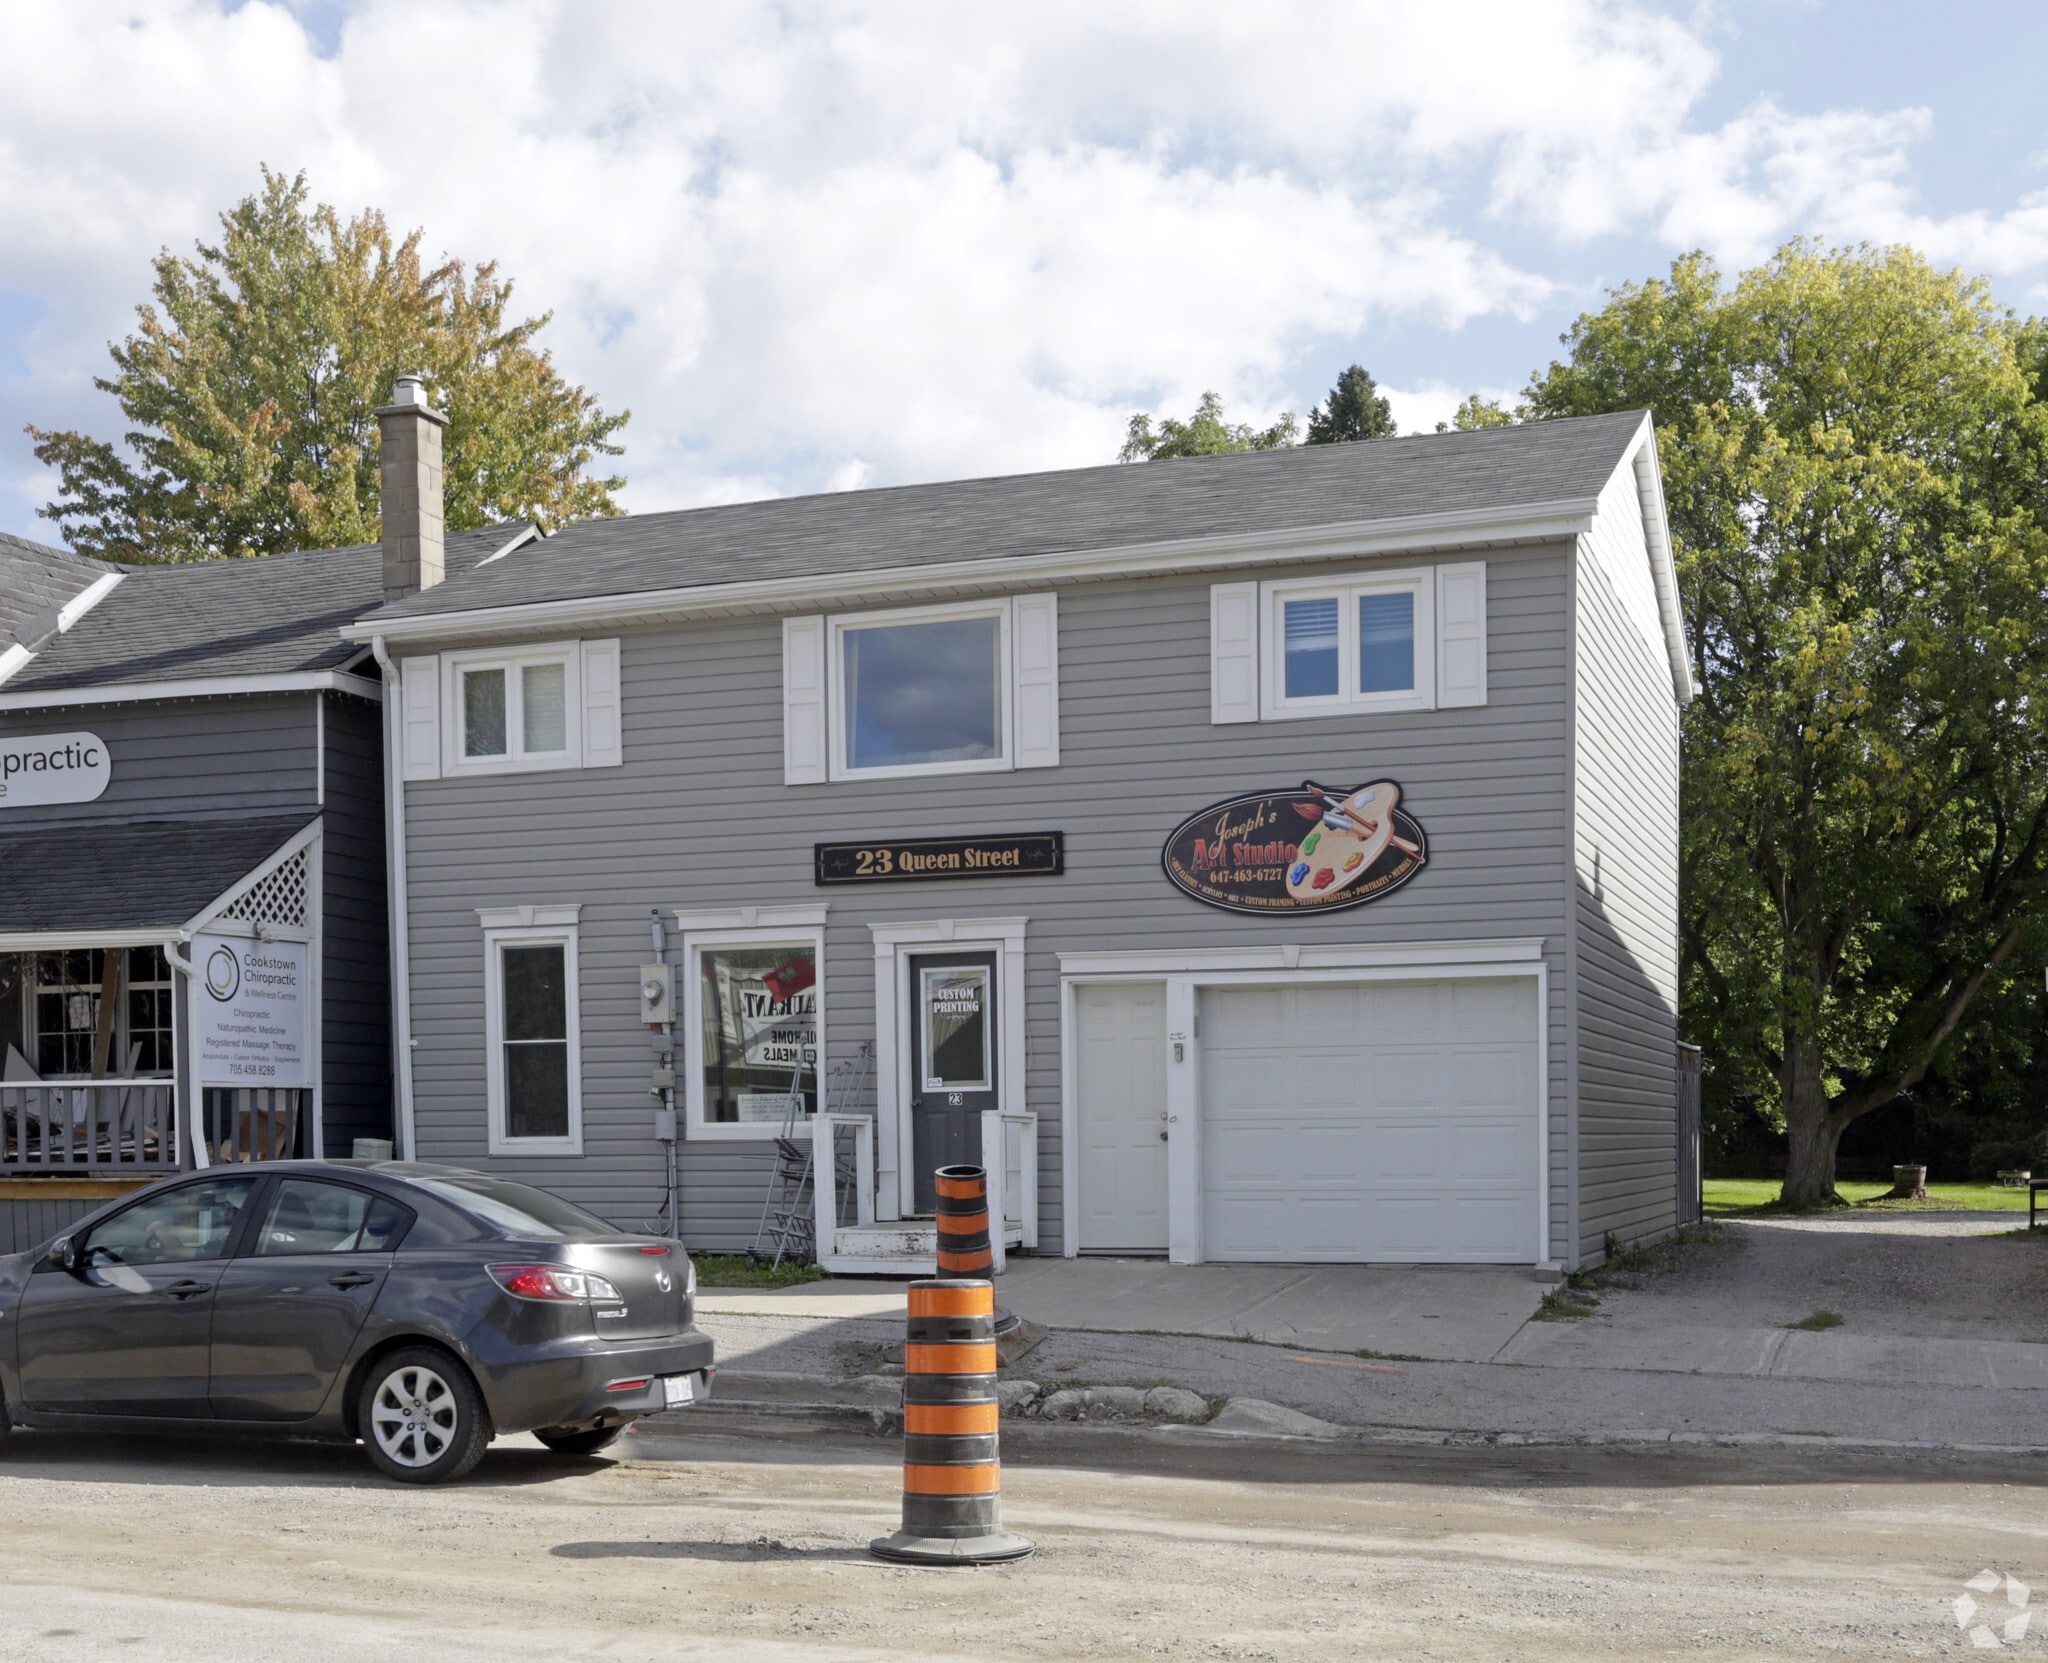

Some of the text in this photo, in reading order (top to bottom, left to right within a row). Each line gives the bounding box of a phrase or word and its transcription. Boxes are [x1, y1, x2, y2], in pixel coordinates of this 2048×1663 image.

[0, 742, 98, 780] practic
[1208, 800, 1277, 860] Joseph's
[855, 848, 1020, 875] 23 Queen Street
[1191, 839, 1298, 871] Art Studio
[1210, 868, 1283, 883] 647-463-6727
[1245, 895, 1267, 906] CUSTOM
[1268, 897, 1295, 907] FRAMING
[1355, 874, 1390, 896] PORTRAITS
[1391, 857, 1413, 879] MURALS
[244, 953, 296, 971] Cookstown
[244, 969, 296, 986] Chiropractic
[245, 988, 297, 1002] & Wellness Centre
[938, 987, 975, 1000] CUSTOM
[233, 1008, 270, 1020] Chiropractic
[933, 1001, 980, 1013] PRINTING
[217, 1023, 286, 1036] Naturopathic Medicine
[206, 1037, 297, 1052] Registered Massage Therapy
[229, 1064, 276, 1077] 705.458.8288
[950, 1093, 962, 1105] 23
